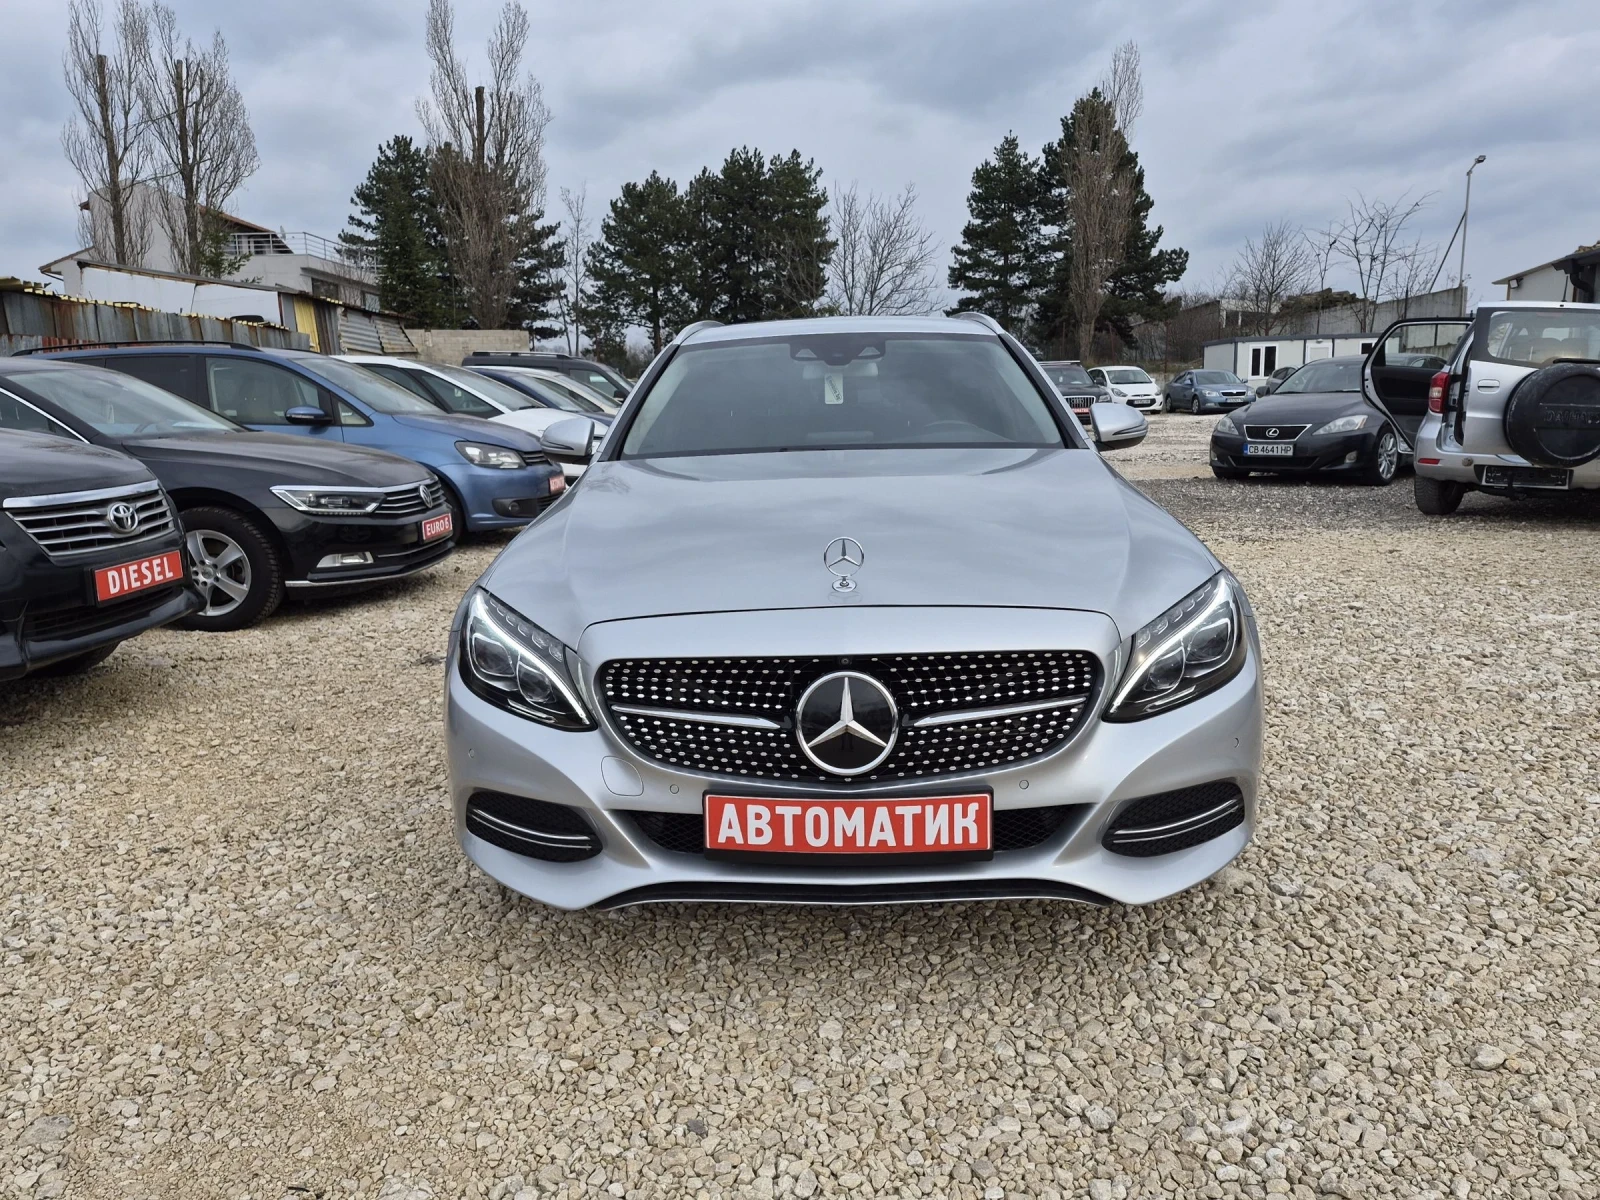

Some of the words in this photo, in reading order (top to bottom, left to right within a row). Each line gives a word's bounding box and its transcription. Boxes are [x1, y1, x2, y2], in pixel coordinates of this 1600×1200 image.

[1260, 445, 1279, 454] 4641
[426, 519, 444, 536] EURO
[444, 517, 449, 529] 6
[107, 556, 174, 594] DIESEL
[717, 802, 980, 847] АВТОМАТИК
